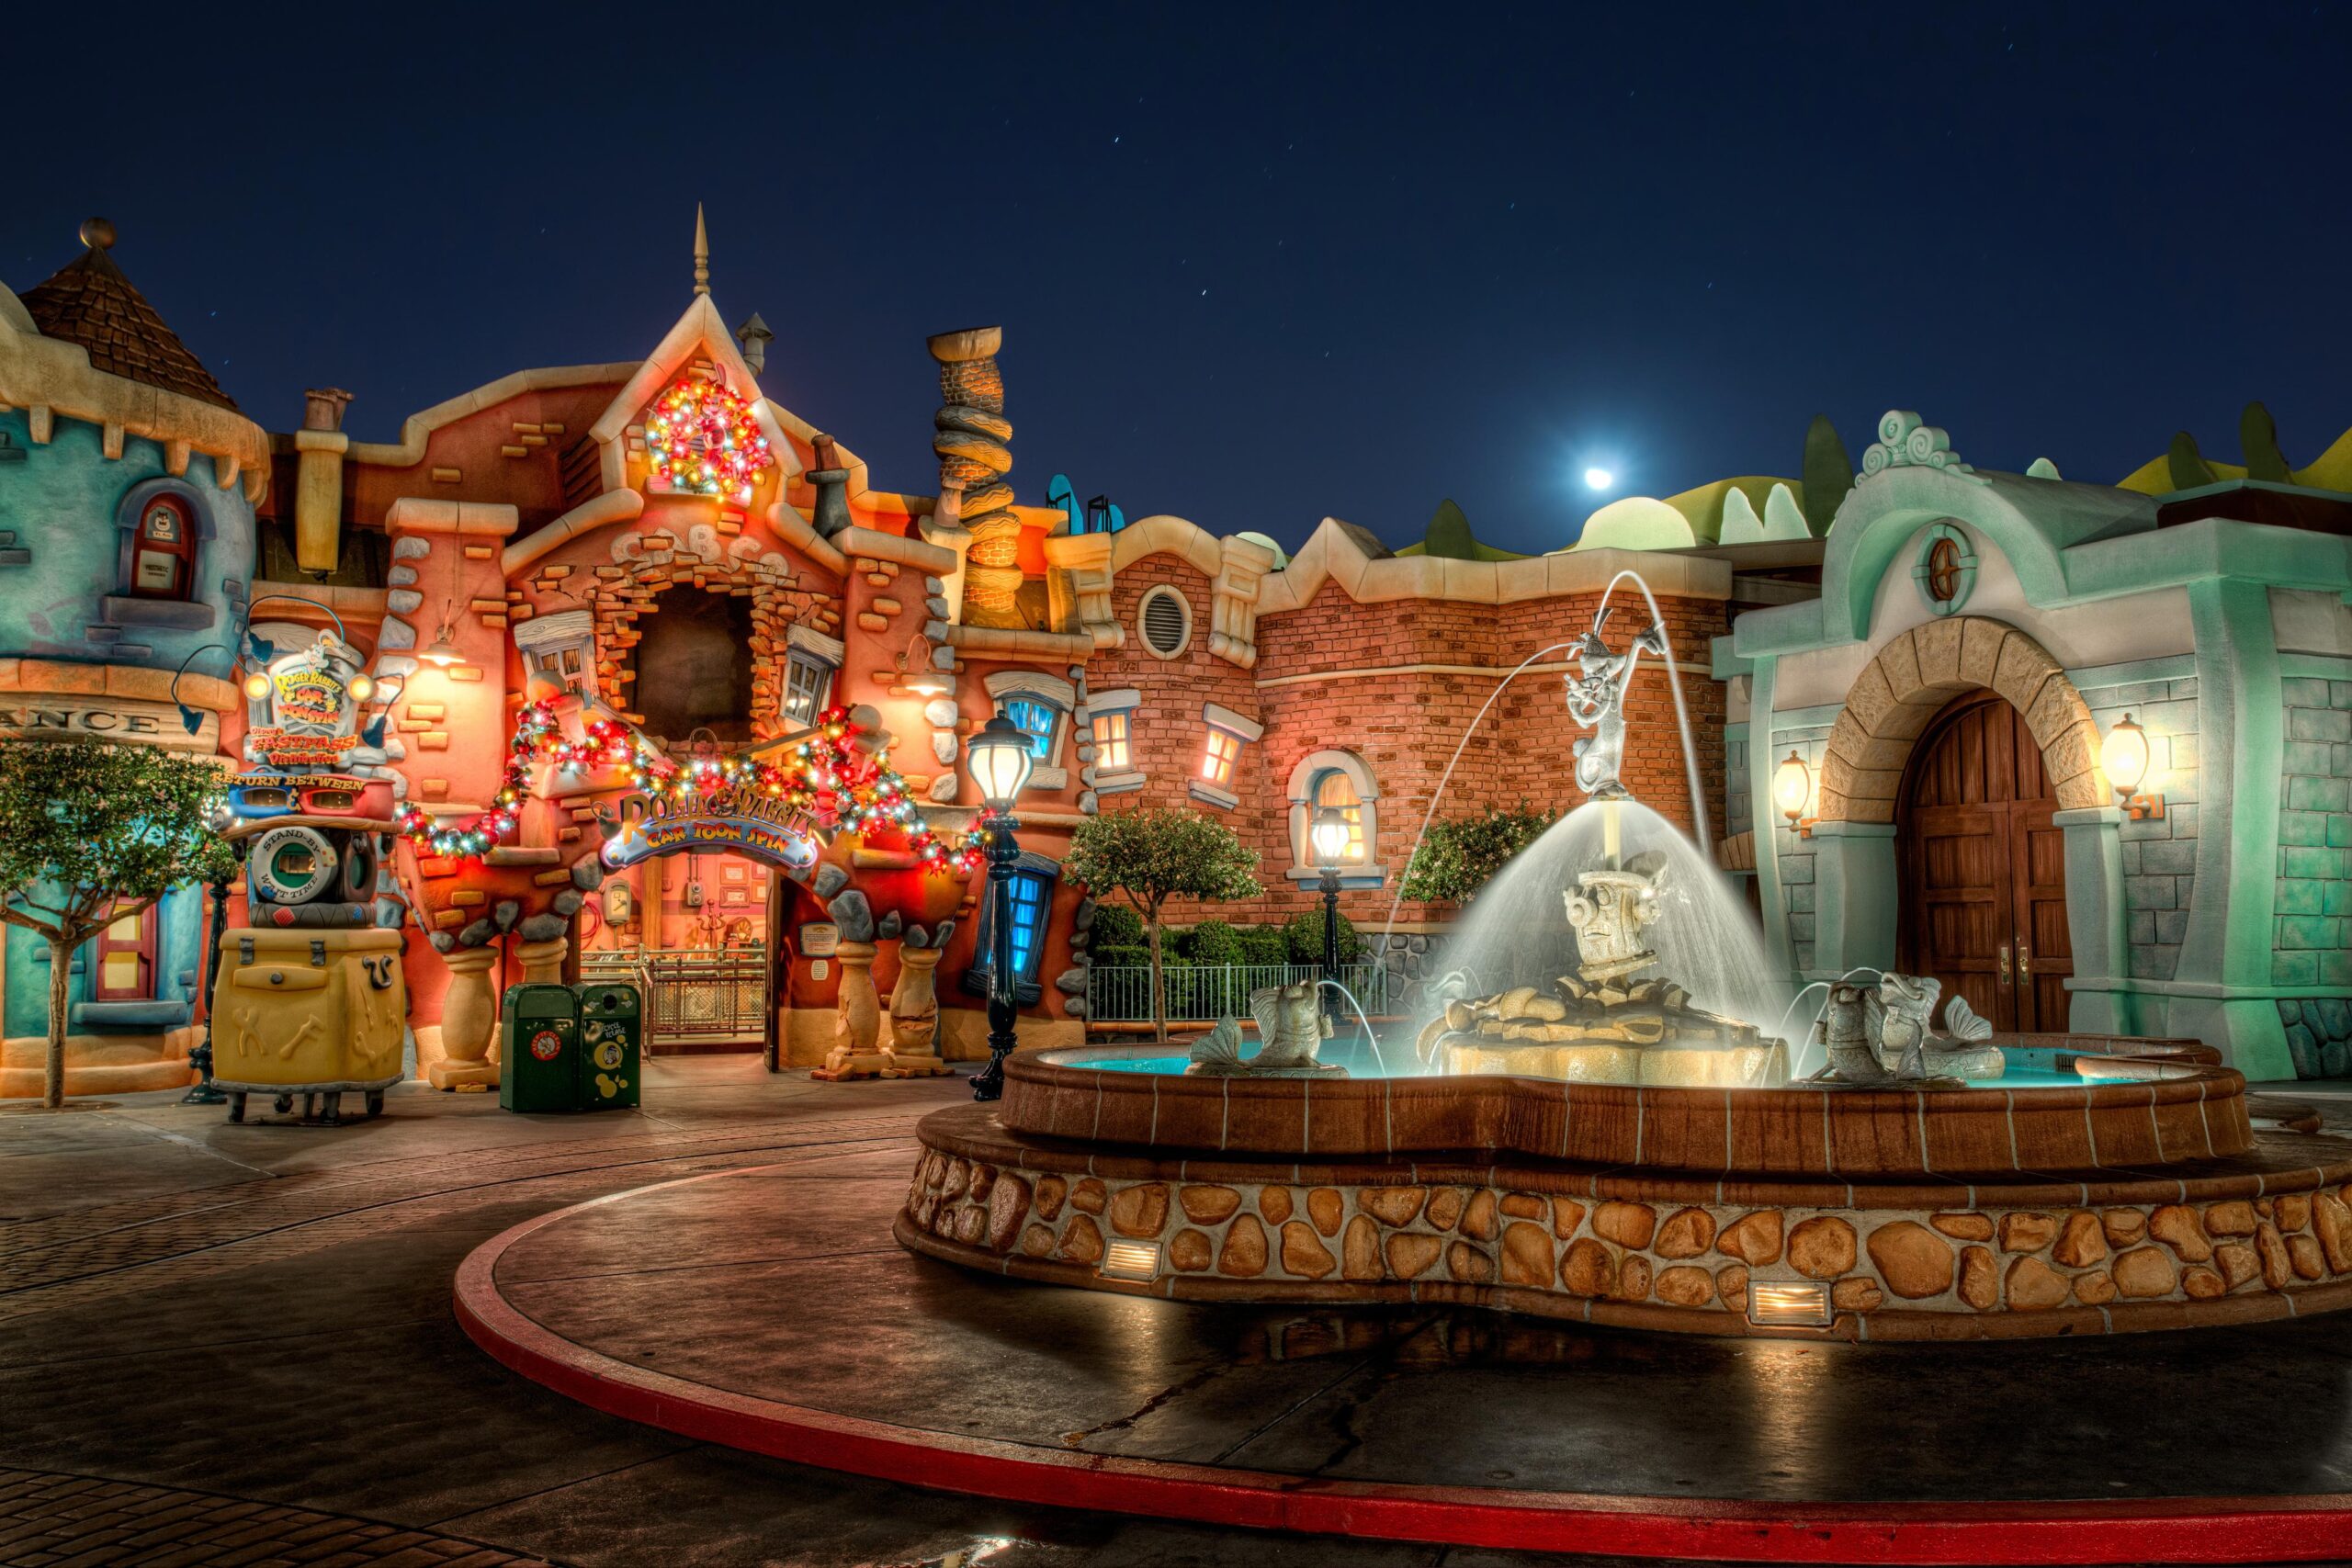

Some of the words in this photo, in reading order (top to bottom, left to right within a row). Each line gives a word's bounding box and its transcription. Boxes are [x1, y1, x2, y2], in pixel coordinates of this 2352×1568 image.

[275, 672, 310, 695] ROGER
[252, 734, 358, 751] FASTPASS
[211, 773, 281, 787] RETURN
[285, 774, 367, 791] BETWEEN
[286, 788, 301, 811] &
[620, 792, 707, 845] ROGER
[263, 829, 321, 853] STAND-BY
[646, 825, 687, 848] CAR
[693, 822, 742, 841] TOON
[745, 827, 790, 854] SPIN
[289, 875, 318, 898] TIME
